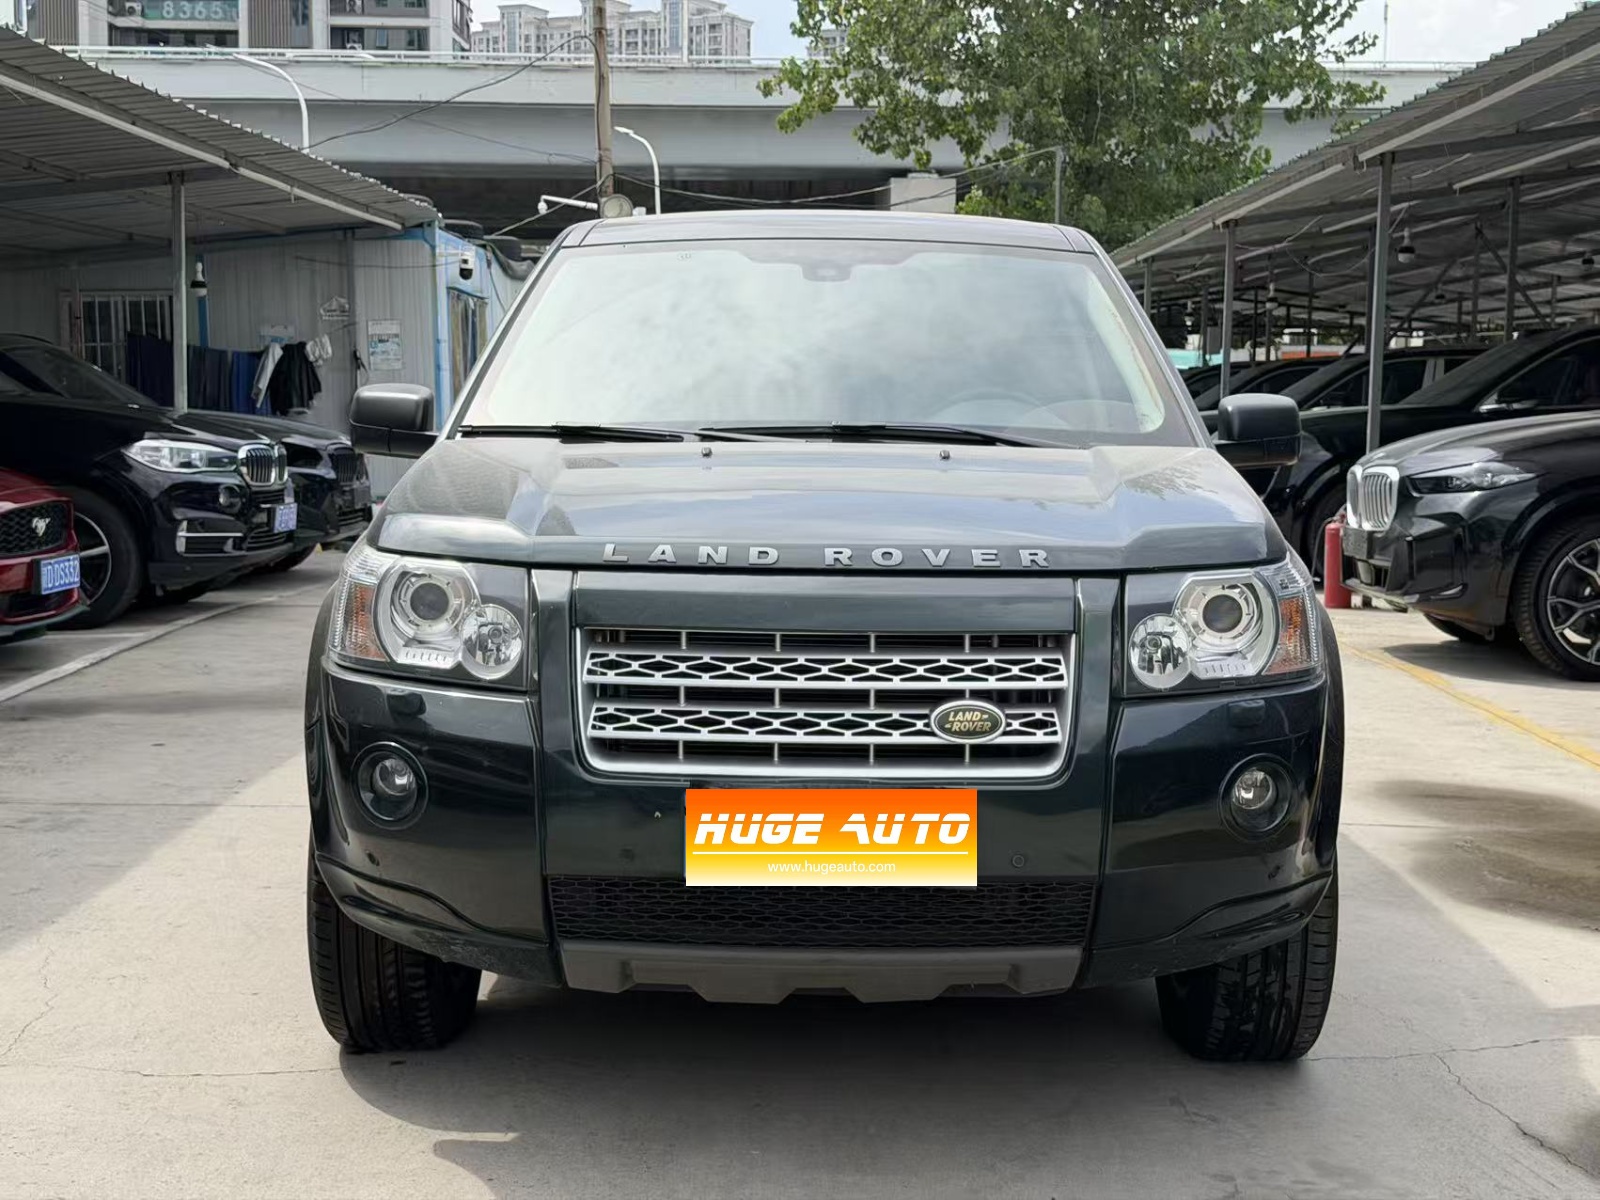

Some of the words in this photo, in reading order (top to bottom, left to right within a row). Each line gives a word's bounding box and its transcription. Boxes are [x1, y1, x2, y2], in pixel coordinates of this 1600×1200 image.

[162, 1, 223, 19] 8365
[603, 543, 779, 565] LAND
[824, 547, 1049, 567] ROVER
[42, 560, 80, 589] DDS332
[948, 711, 981, 721] LAND
[951, 721, 992, 732] ROVER
